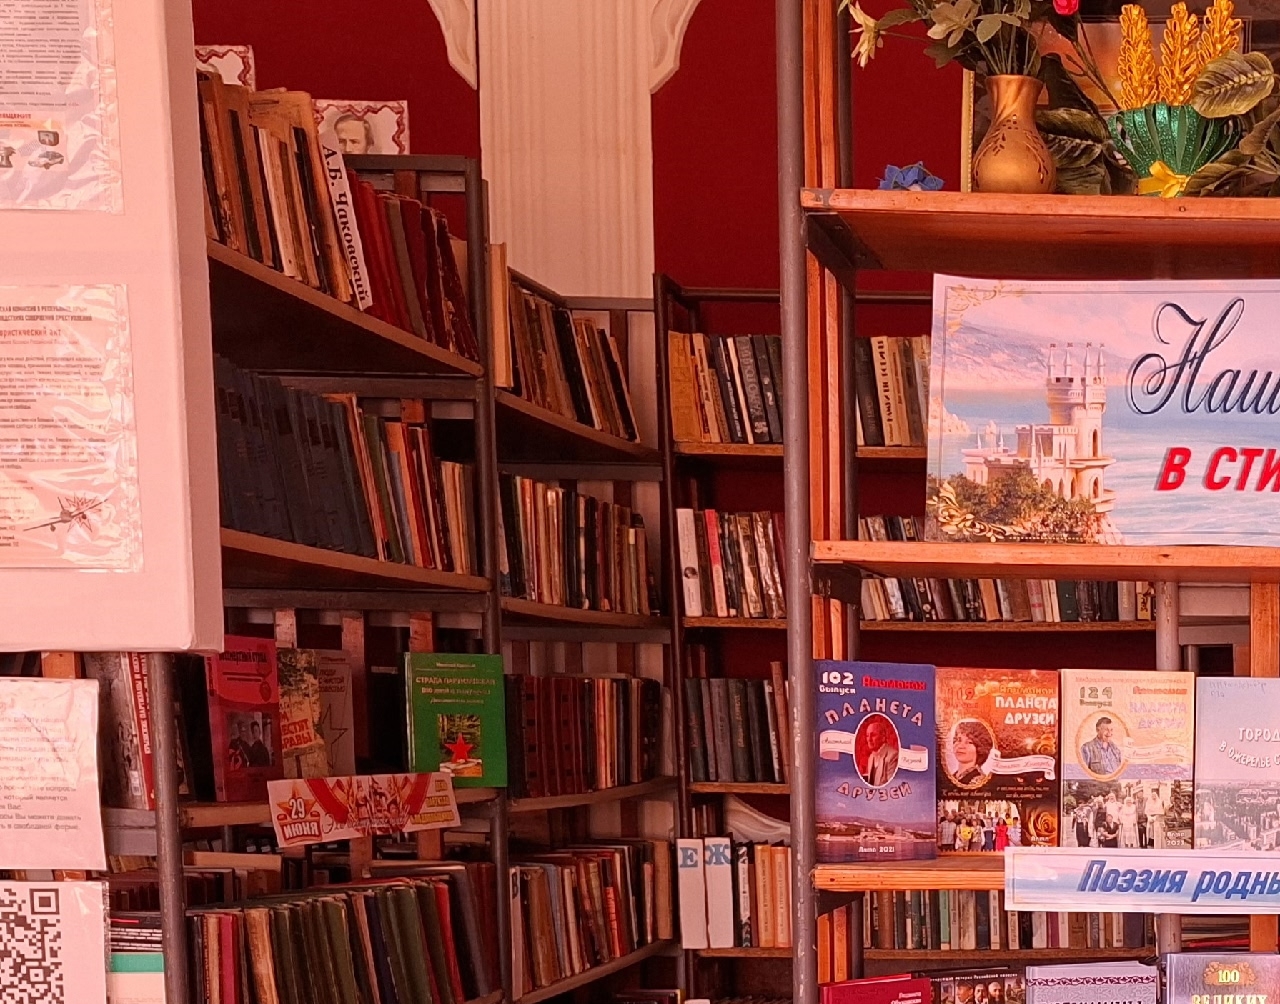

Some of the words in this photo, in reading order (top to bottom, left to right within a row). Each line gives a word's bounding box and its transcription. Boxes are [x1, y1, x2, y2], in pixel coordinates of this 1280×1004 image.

[335, 191, 370, 301] Чаковский
[1158, 448, 1187, 493] в
[822, 671, 854, 685] 102
[995, 696, 1058, 710] ПЛАНЕТА
[1080, 686, 1113, 699] 124
[824, 698, 923, 727] ПЛАНЕТА
[1004, 712, 1056, 726] ДРУЗЕЙ
[1219, 740, 1227, 752] В
[1228, 746, 1271, 769] ОЖЕРЕЛЬЕ
[836, 782, 913, 802] ДРУЗЕЙ
[288, 796, 305, 820] 29
[283, 821, 319, 840] ИЮНЯ
[705, 843, 733, 866] Ж
[1077, 859, 1183, 894] Поэзия
[1218, 969, 1240, 983] 100
